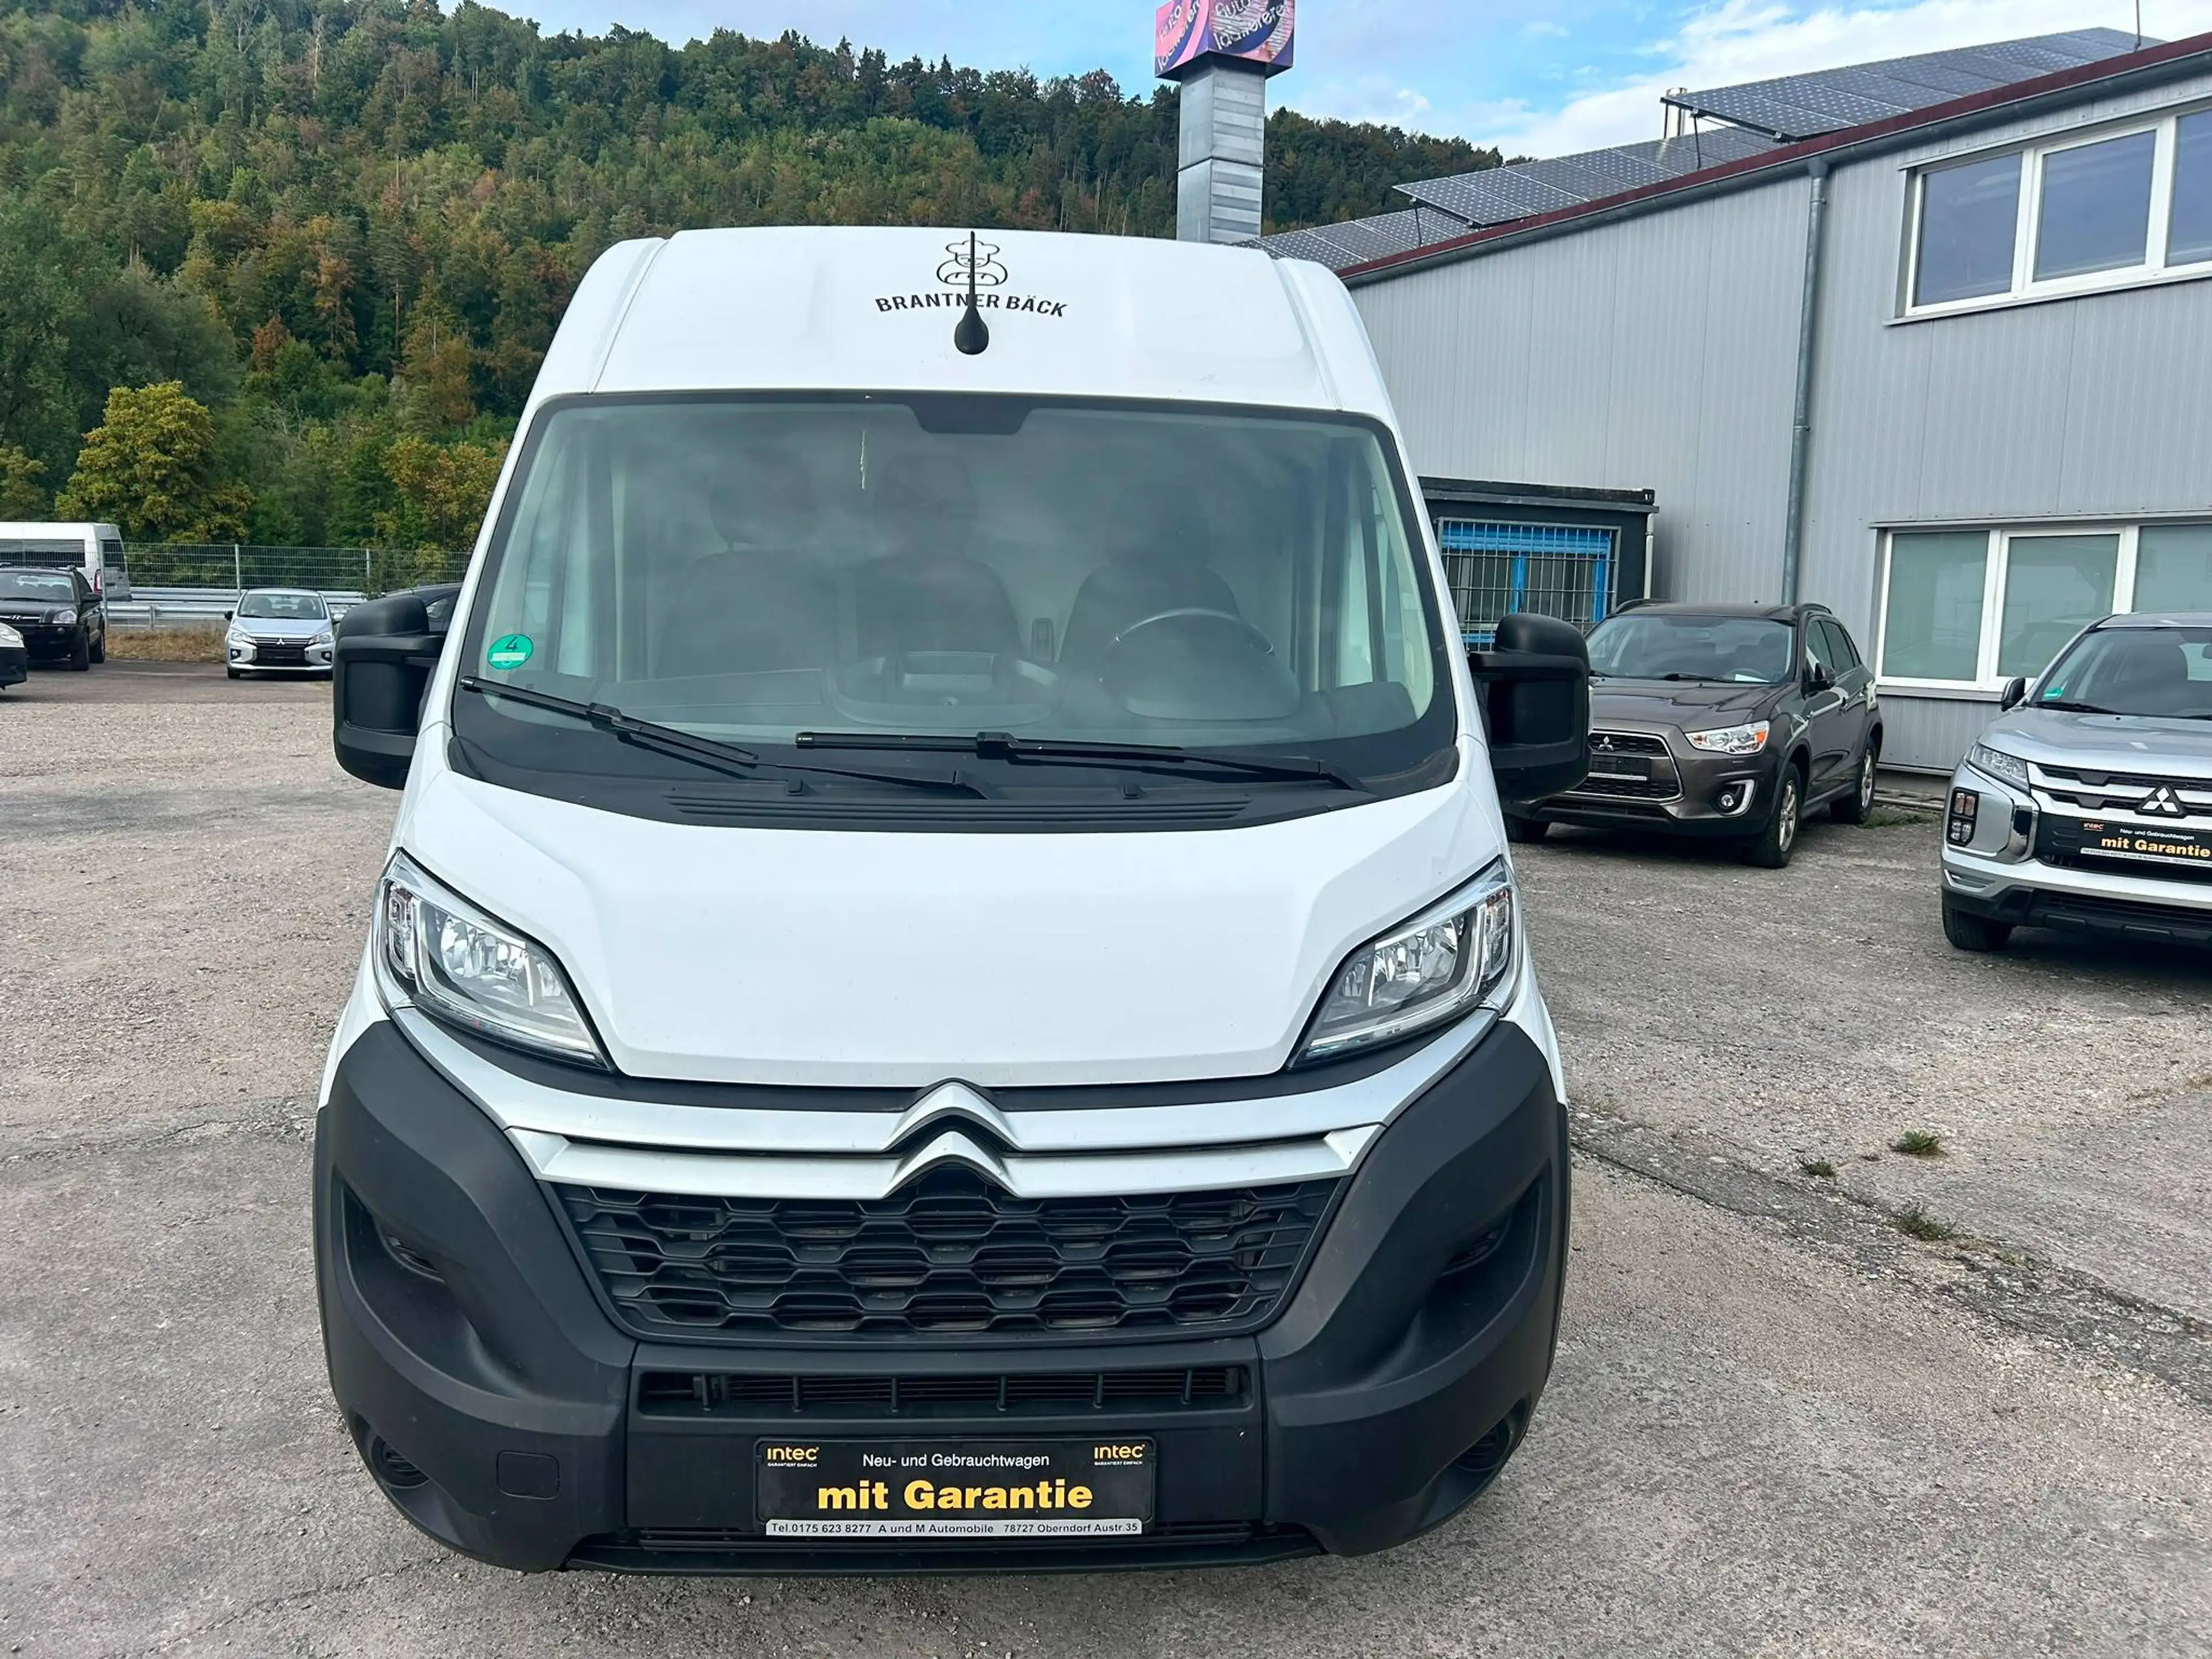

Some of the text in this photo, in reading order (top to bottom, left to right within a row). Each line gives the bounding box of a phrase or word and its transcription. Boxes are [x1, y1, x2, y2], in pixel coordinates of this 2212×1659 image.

[875, 293, 1068, 317] BRANTNER BÄCK
[505, 636, 518, 651] 4
[2101, 837, 2130, 849] mit
[2134, 839, 2211, 858] Garantie
[767, 1446, 820, 1461] intec
[1094, 1444, 1146, 1459] intec
[863, 1453, 1050, 1469] Neu- und Gebrauchtwagen
[818, 1478, 1093, 1510] mit Garantie
[822, 1524, 841, 1533] 623
[845, 1524, 871, 1533] 8277
[878, 1524, 887, 1533] A
[891, 1524, 912, 1533] und
[916, 1525, 925, 1533] M
[929, 1524, 994, 1533] Automobile
[1003, 1524, 1034, 1533] 78727
[1037, 1524, 1090, 1533] Oberndorf
